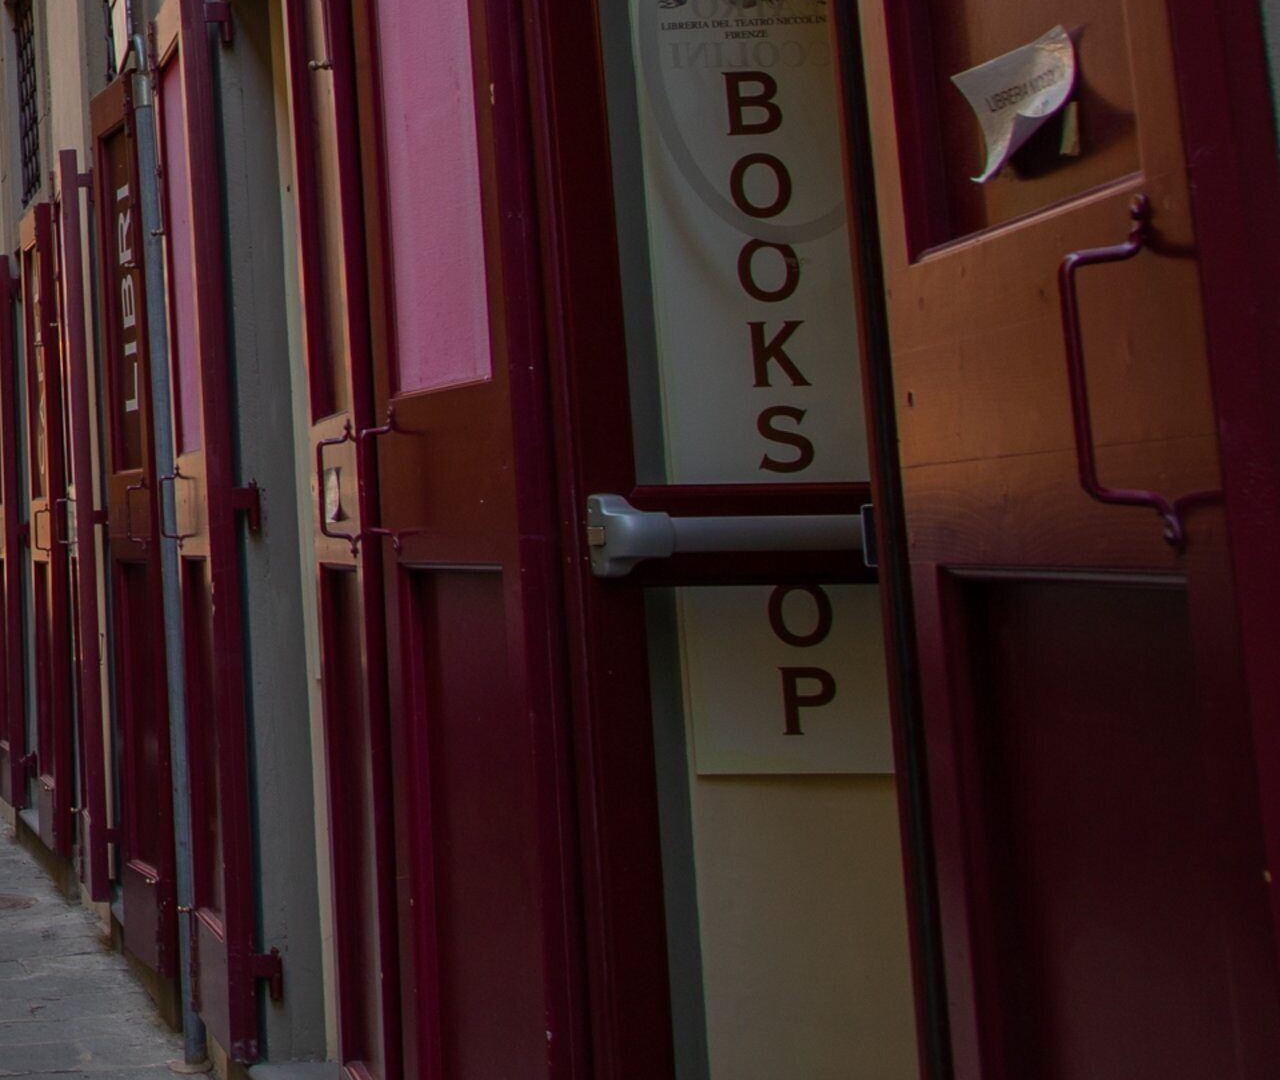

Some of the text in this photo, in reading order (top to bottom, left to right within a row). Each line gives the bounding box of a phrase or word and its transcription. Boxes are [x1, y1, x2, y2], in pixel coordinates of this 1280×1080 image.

[661, 21, 710, 31] LIBRERIA
[712, 19, 732, 29] DEL
[736, 17, 774, 28] TEATRO
[725, 29, 768, 39] FIRENZE
[115, 183, 139, 413] LIBRI
[722, 71, 836, 736] BOOKSOP
